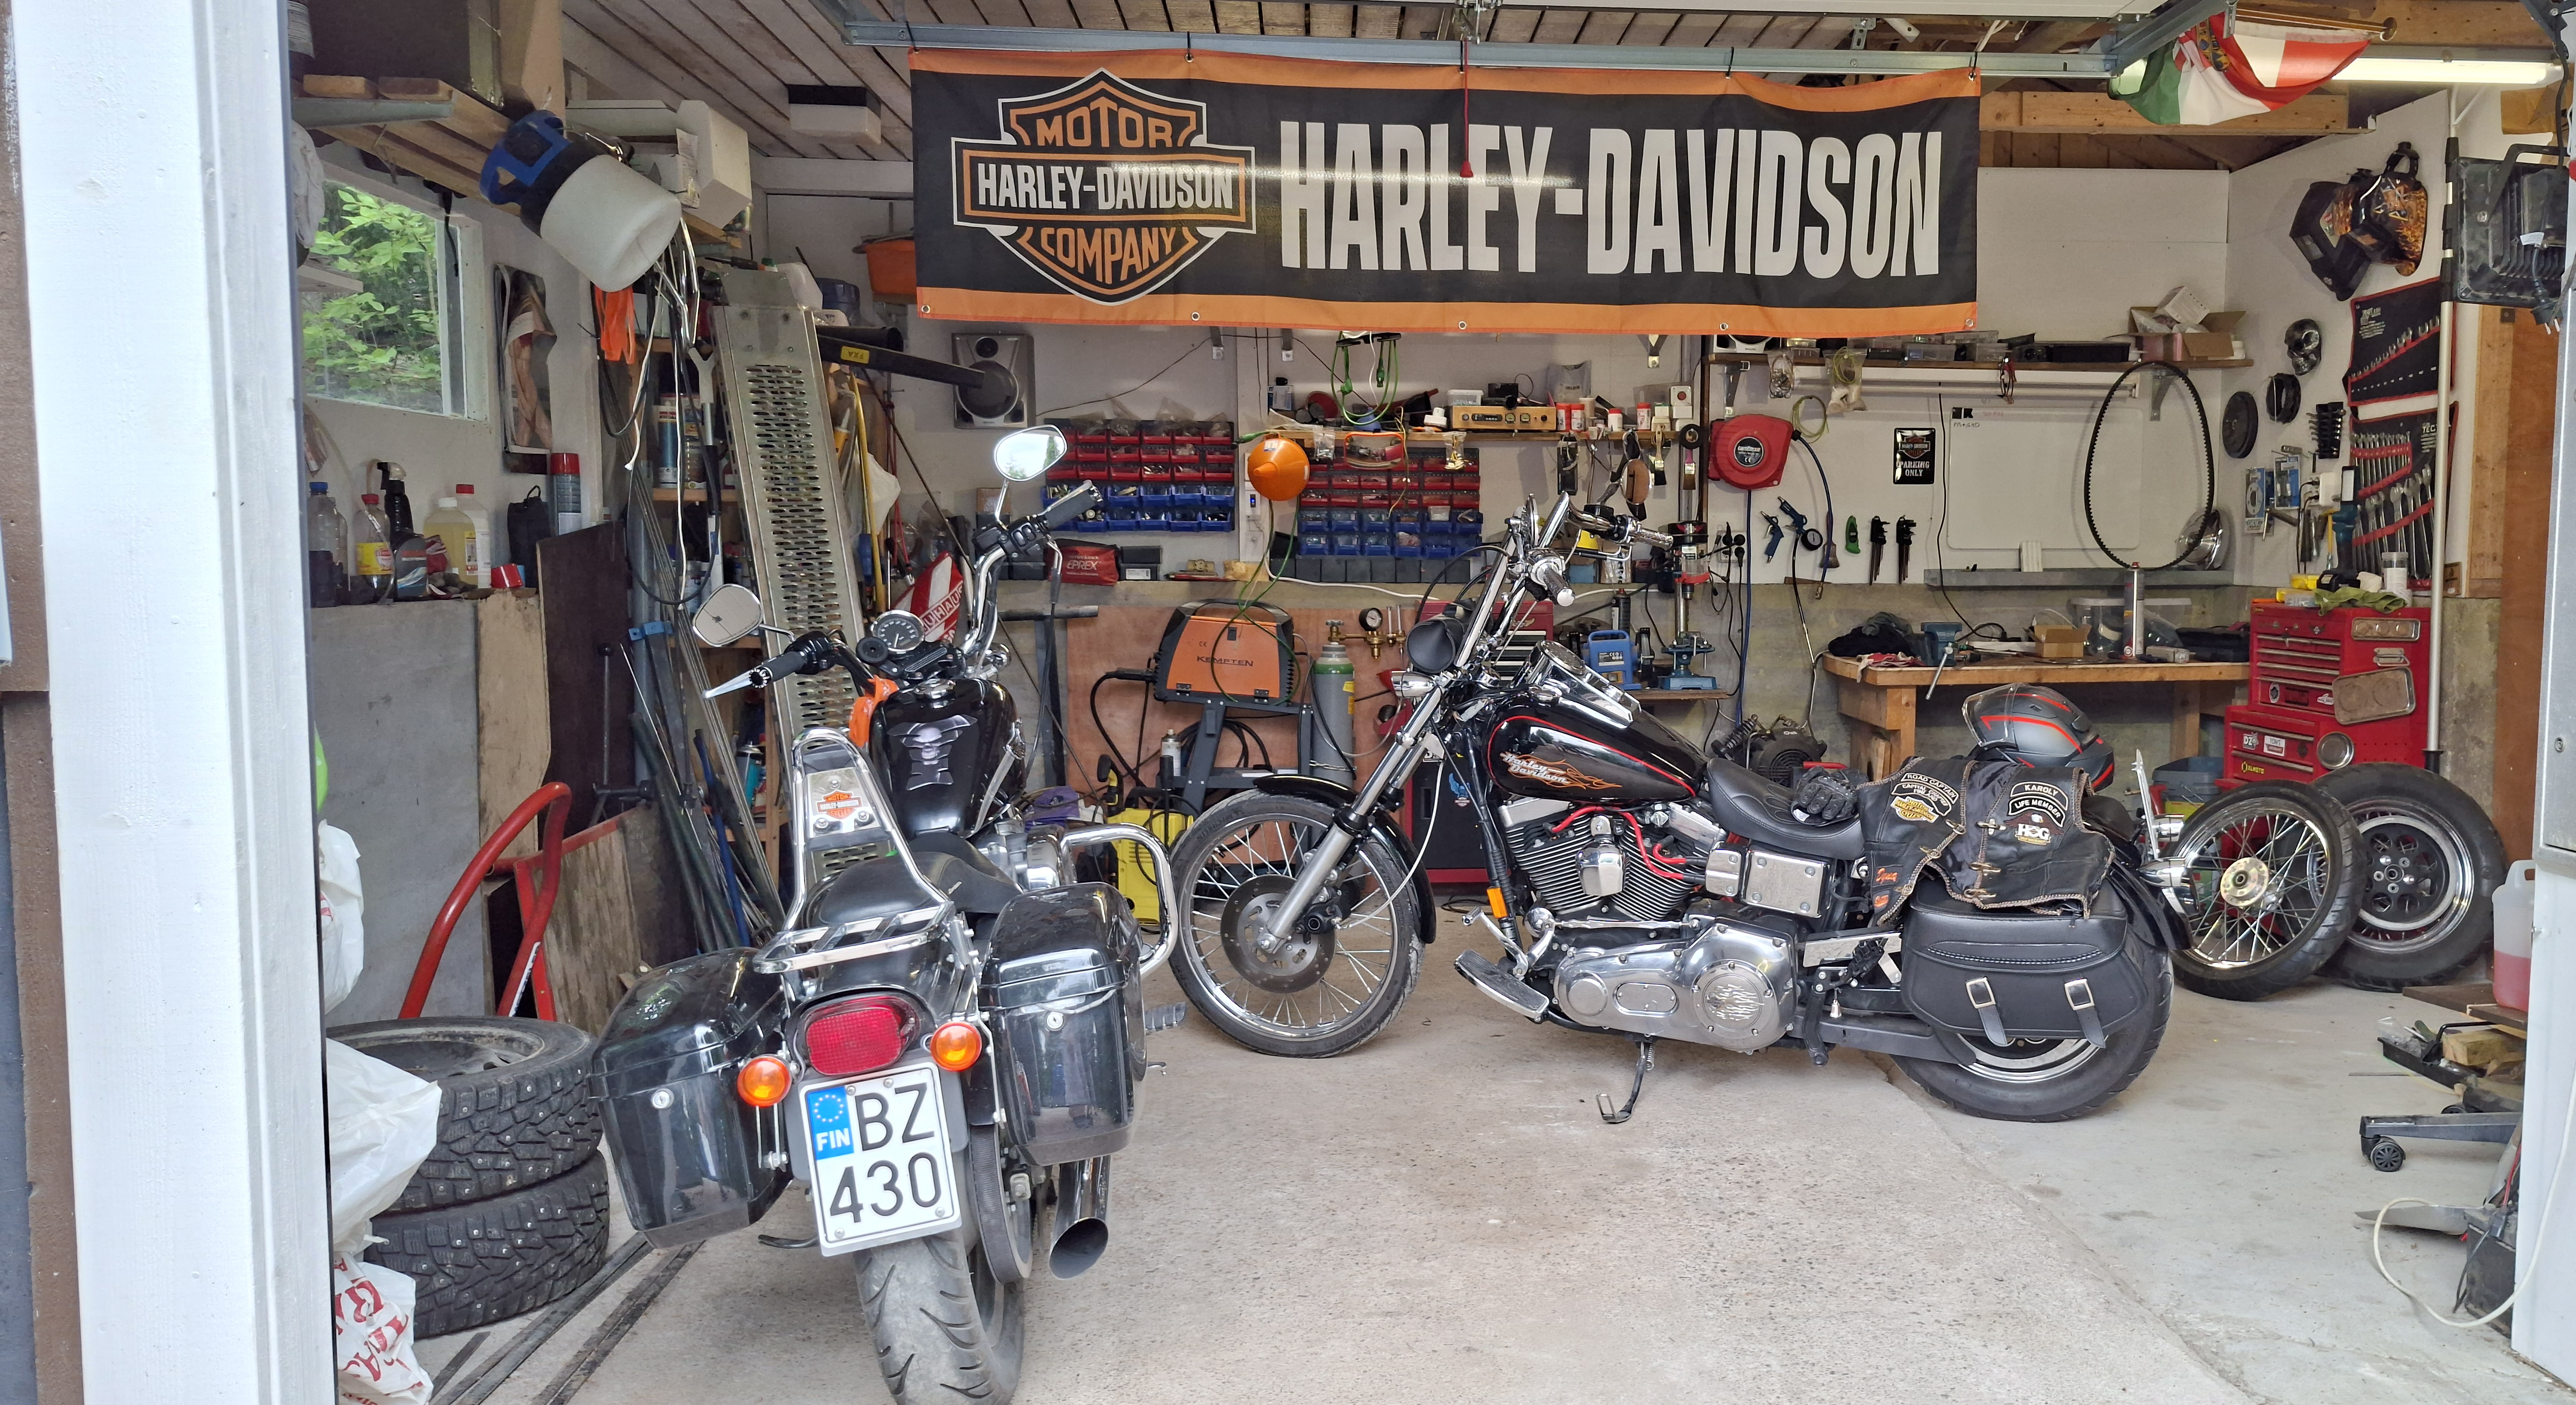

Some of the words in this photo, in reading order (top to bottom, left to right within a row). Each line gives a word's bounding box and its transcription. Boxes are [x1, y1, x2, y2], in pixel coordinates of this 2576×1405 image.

[1036, 96, 1173, 148] MOTOR
[977, 163, 1233, 210] HARLEY-DAVIDSON
[1281, 121, 1941, 279] HARLEY-DAVIDSON
[1041, 227, 1176, 285] COMPANY
[1066, 560, 1098, 571] EPREX
[1197, 656, 1253, 667] KEMPTEN
[1510, 763, 1571, 783] Davidson
[1929, 779, 1956, 798] CAPTAIN
[2024, 784, 2059, 796] KAROLY
[2014, 799, 2030, 809] LIFE
[2031, 799, 2061, 818] MEMBER
[854, 1082, 935, 1151] BZ
[816, 1128, 850, 1151] FIN
[830, 1152, 942, 1223] 430
